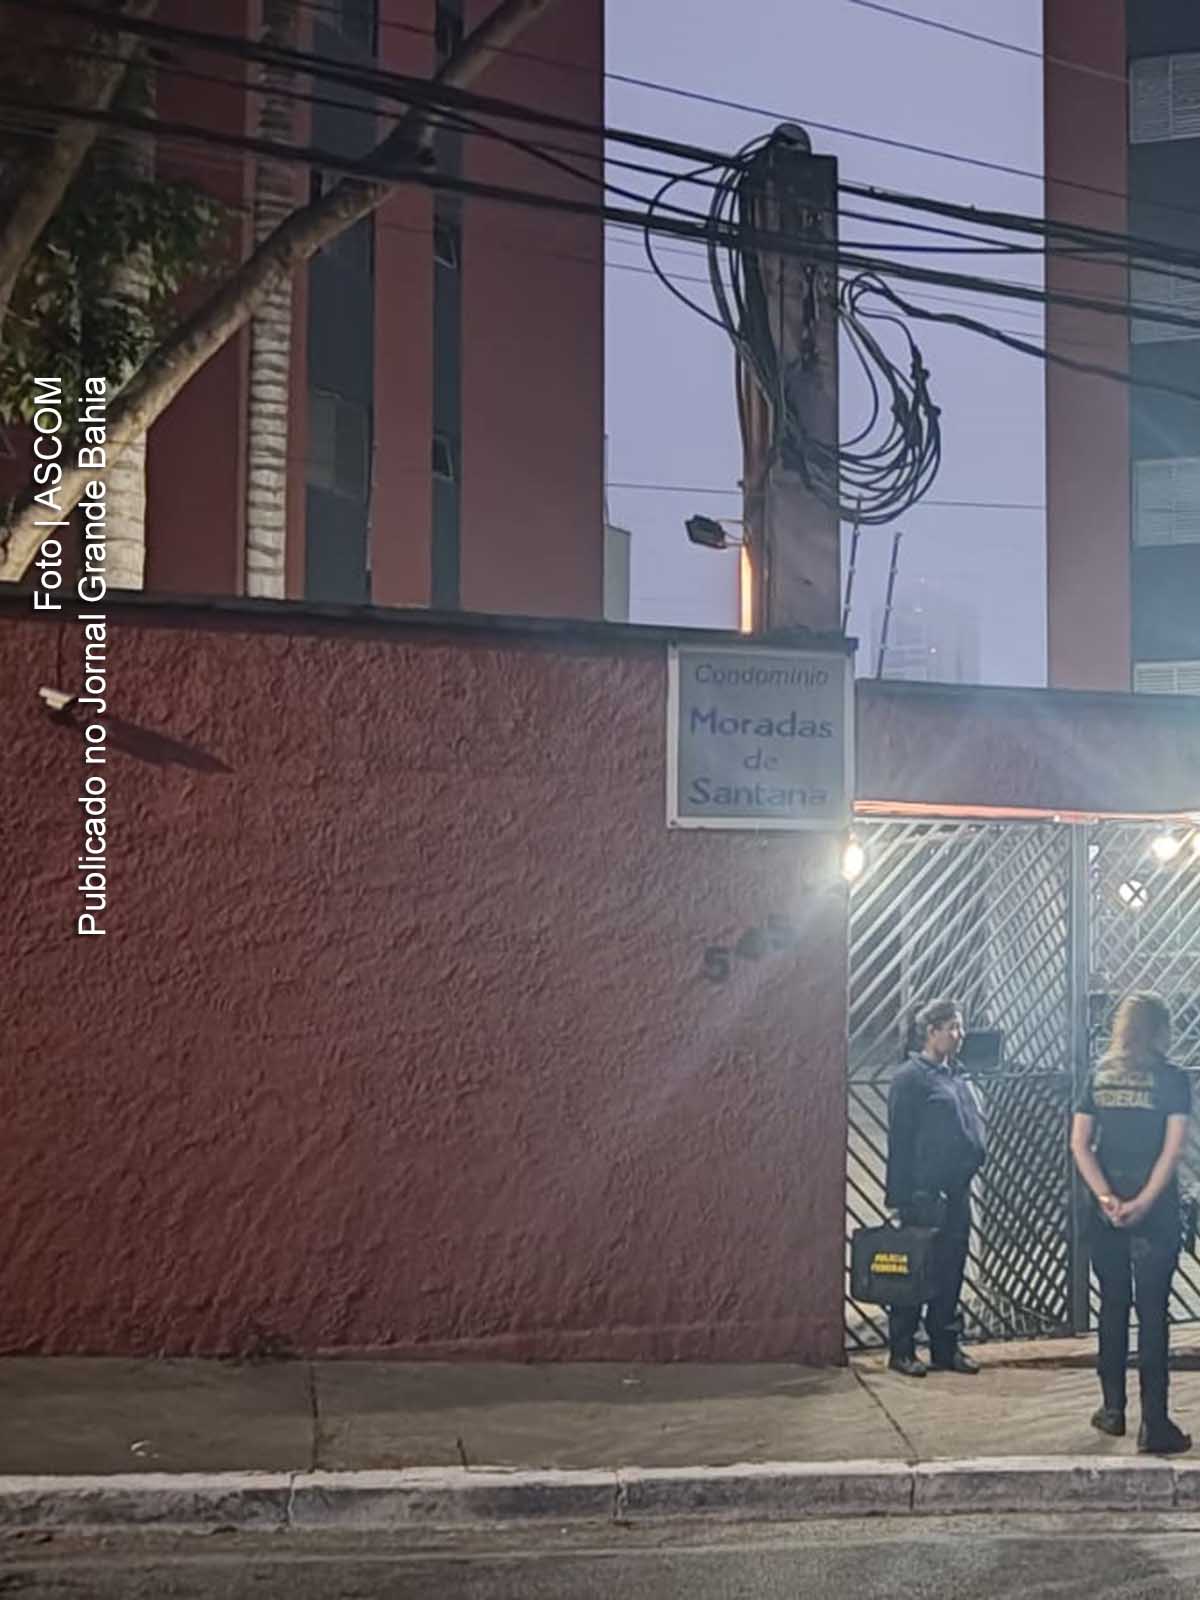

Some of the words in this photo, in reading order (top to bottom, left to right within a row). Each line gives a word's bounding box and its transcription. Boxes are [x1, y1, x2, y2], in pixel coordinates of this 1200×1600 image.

[690, 708, 833, 738] Moradas
[744, 749, 779, 771] de
[688, 777, 829, 810] Santana
